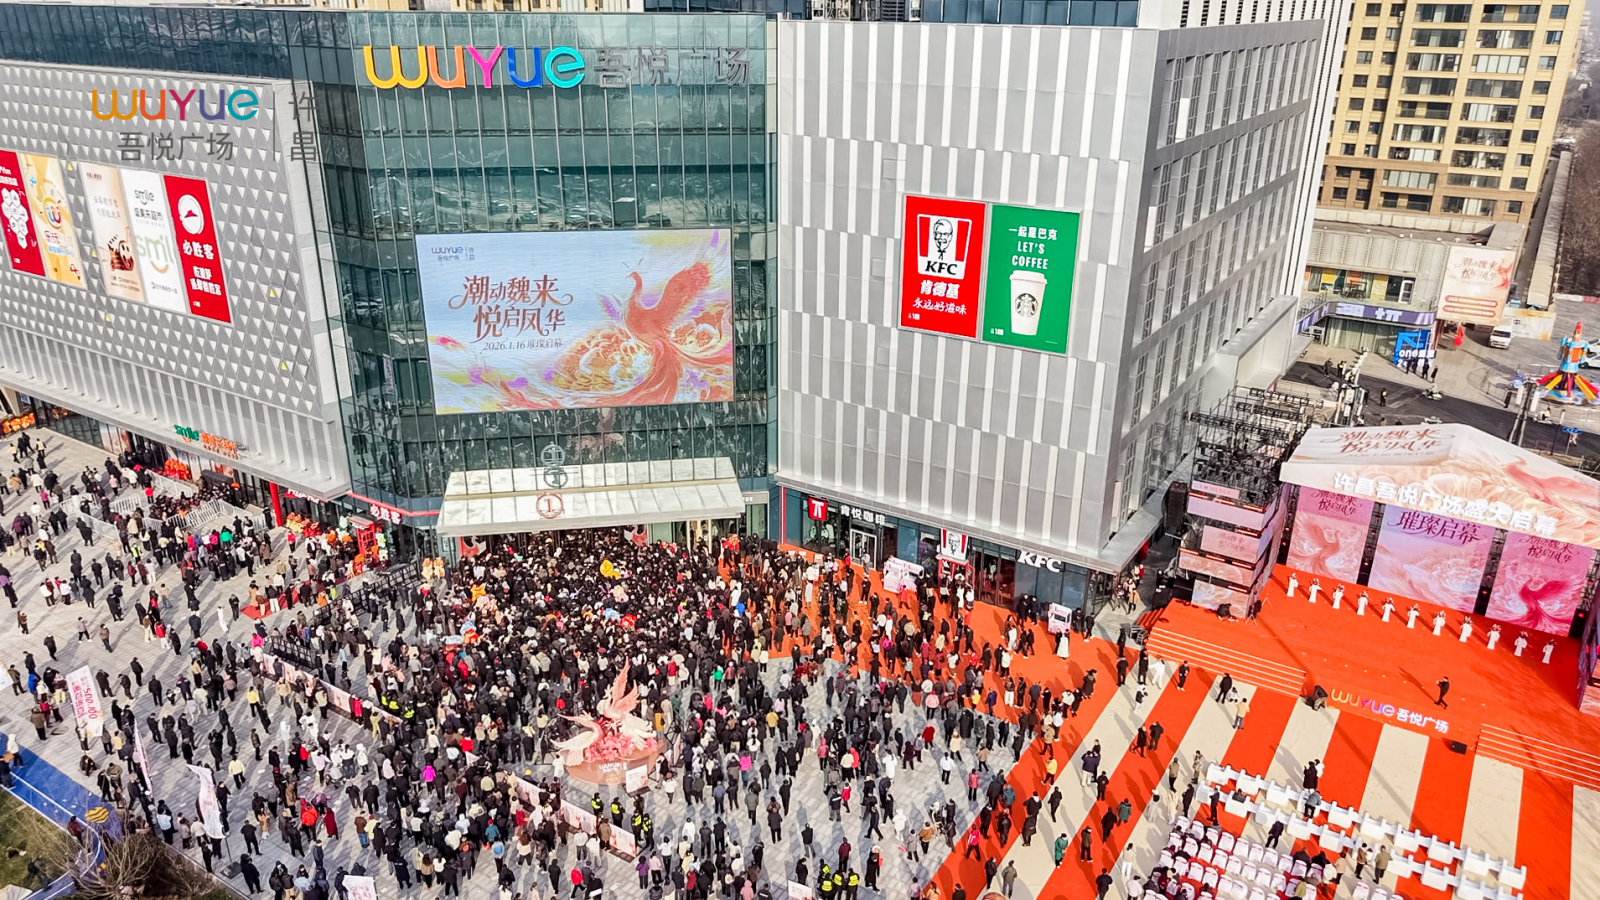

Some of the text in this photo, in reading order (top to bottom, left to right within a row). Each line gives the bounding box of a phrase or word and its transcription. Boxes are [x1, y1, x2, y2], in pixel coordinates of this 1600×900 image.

[593, 46, 751, 88] 吾悦广场
[134, 189, 155, 203] smile
[1009, 225, 1057, 240] 一起星巴克
[183, 239, 214, 260] 必胜客
[1017, 241, 1045, 254] LET'S
[924, 260, 958, 275] KFC
[1012, 255, 1049, 270] COFFEE
[448, 275, 573, 309] 潮动魏来
[920, 279, 961, 299] 肯德基
[912, 297, 967, 315] 永远好滋味
[174, 424, 200, 441] smile
[370, 503, 401, 525] 必胜客
[840, 505, 886, 525] 肯悦咖啡
[1388, 510, 1486, 545] 璀璨启幕
[1018, 550, 1062, 573] KFC
[1396, 708, 1449, 734] 吾悦广场
